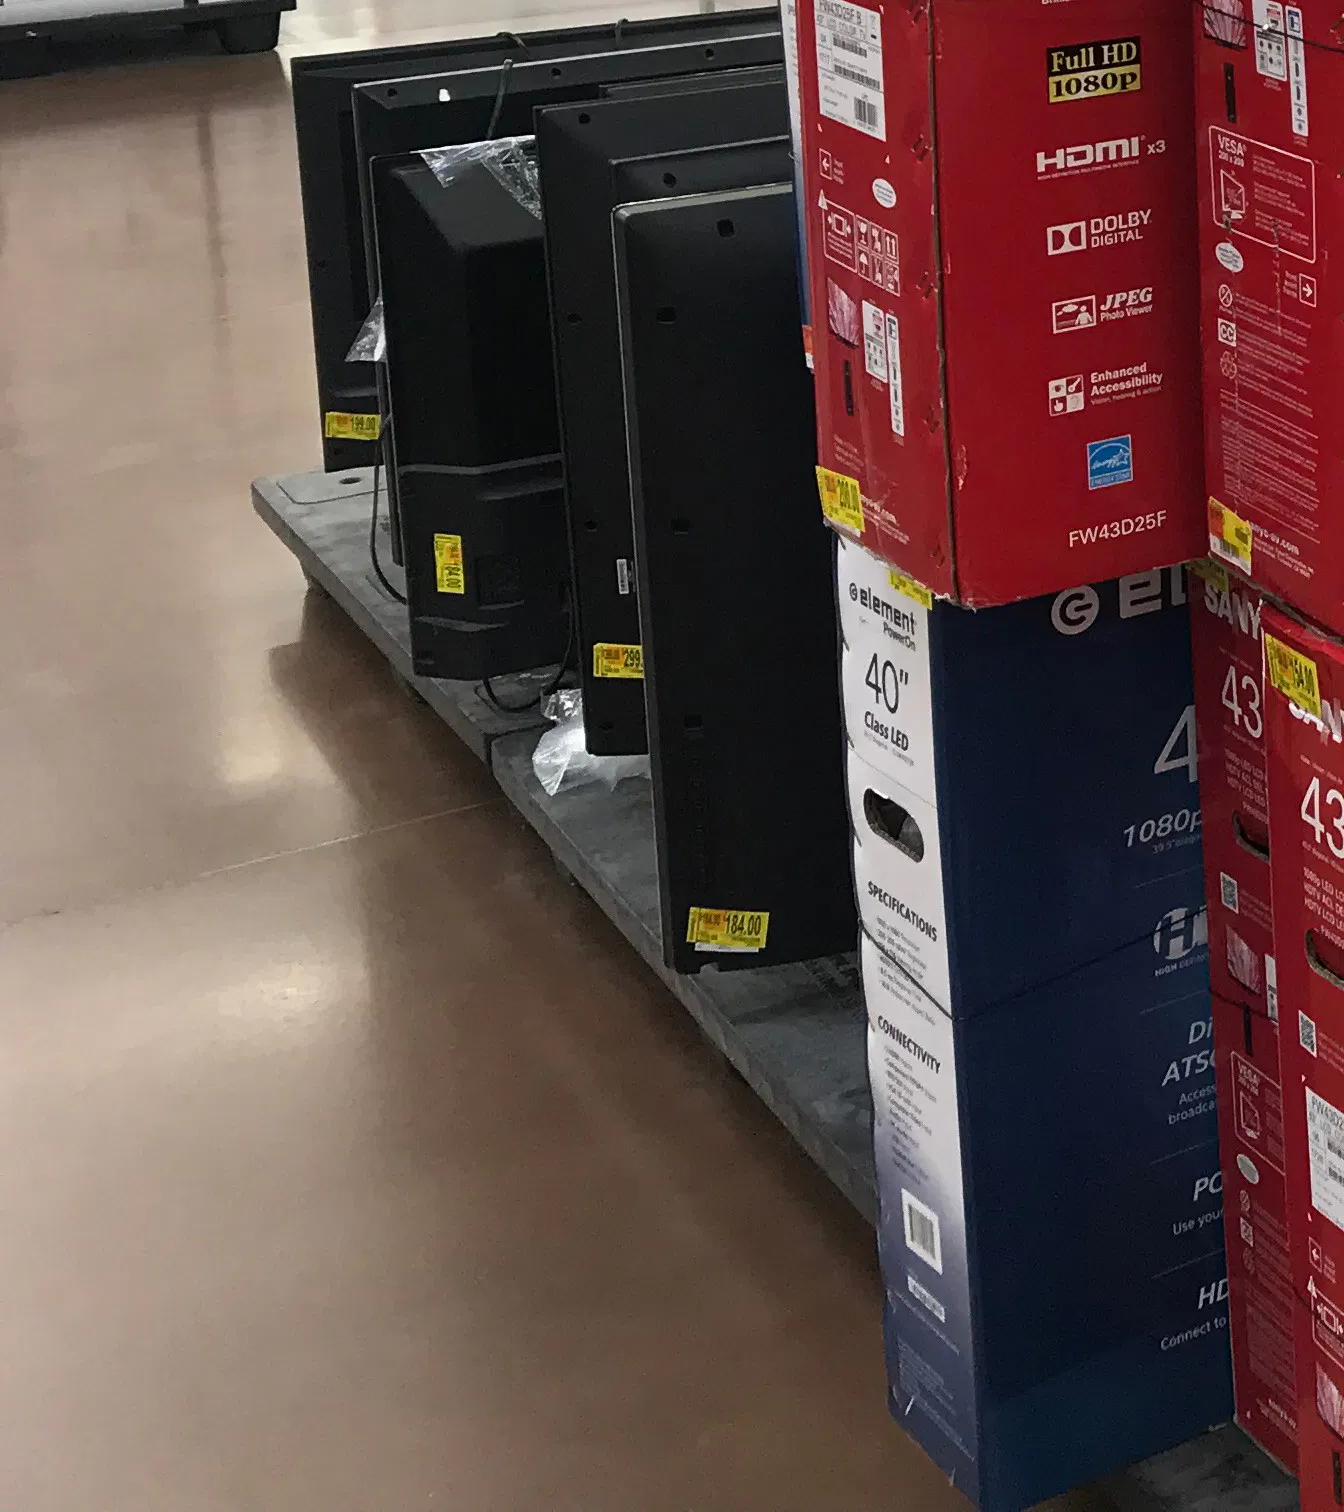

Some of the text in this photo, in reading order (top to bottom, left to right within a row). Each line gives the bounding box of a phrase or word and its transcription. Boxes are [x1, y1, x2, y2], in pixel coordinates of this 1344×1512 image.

[1051, 40, 1138, 73] Full HD
[1052, 69, 1138, 99] 1080p
[1036, 135, 1141, 174] HDMI
[1090, 208, 1152, 235] DOLBY
[1091, 227, 1144, 249] DIGITAL
[1100, 287, 1154, 312] JPEG
[1100, 303, 1154, 323] Photo Viewer
[1090, 361, 1147, 385] Enhanced
[1090, 370, 1164, 397] Accessibility
[1068, 509, 1168, 549] FW43D25F
[859, 583, 916, 636] element
[865, 652, 909, 714] 40"
[864, 710, 909, 752] Class LED
[867, 880, 938, 943] SPECIFICATIONS
[877, 1014, 941, 1075] CONNECTIVITY
